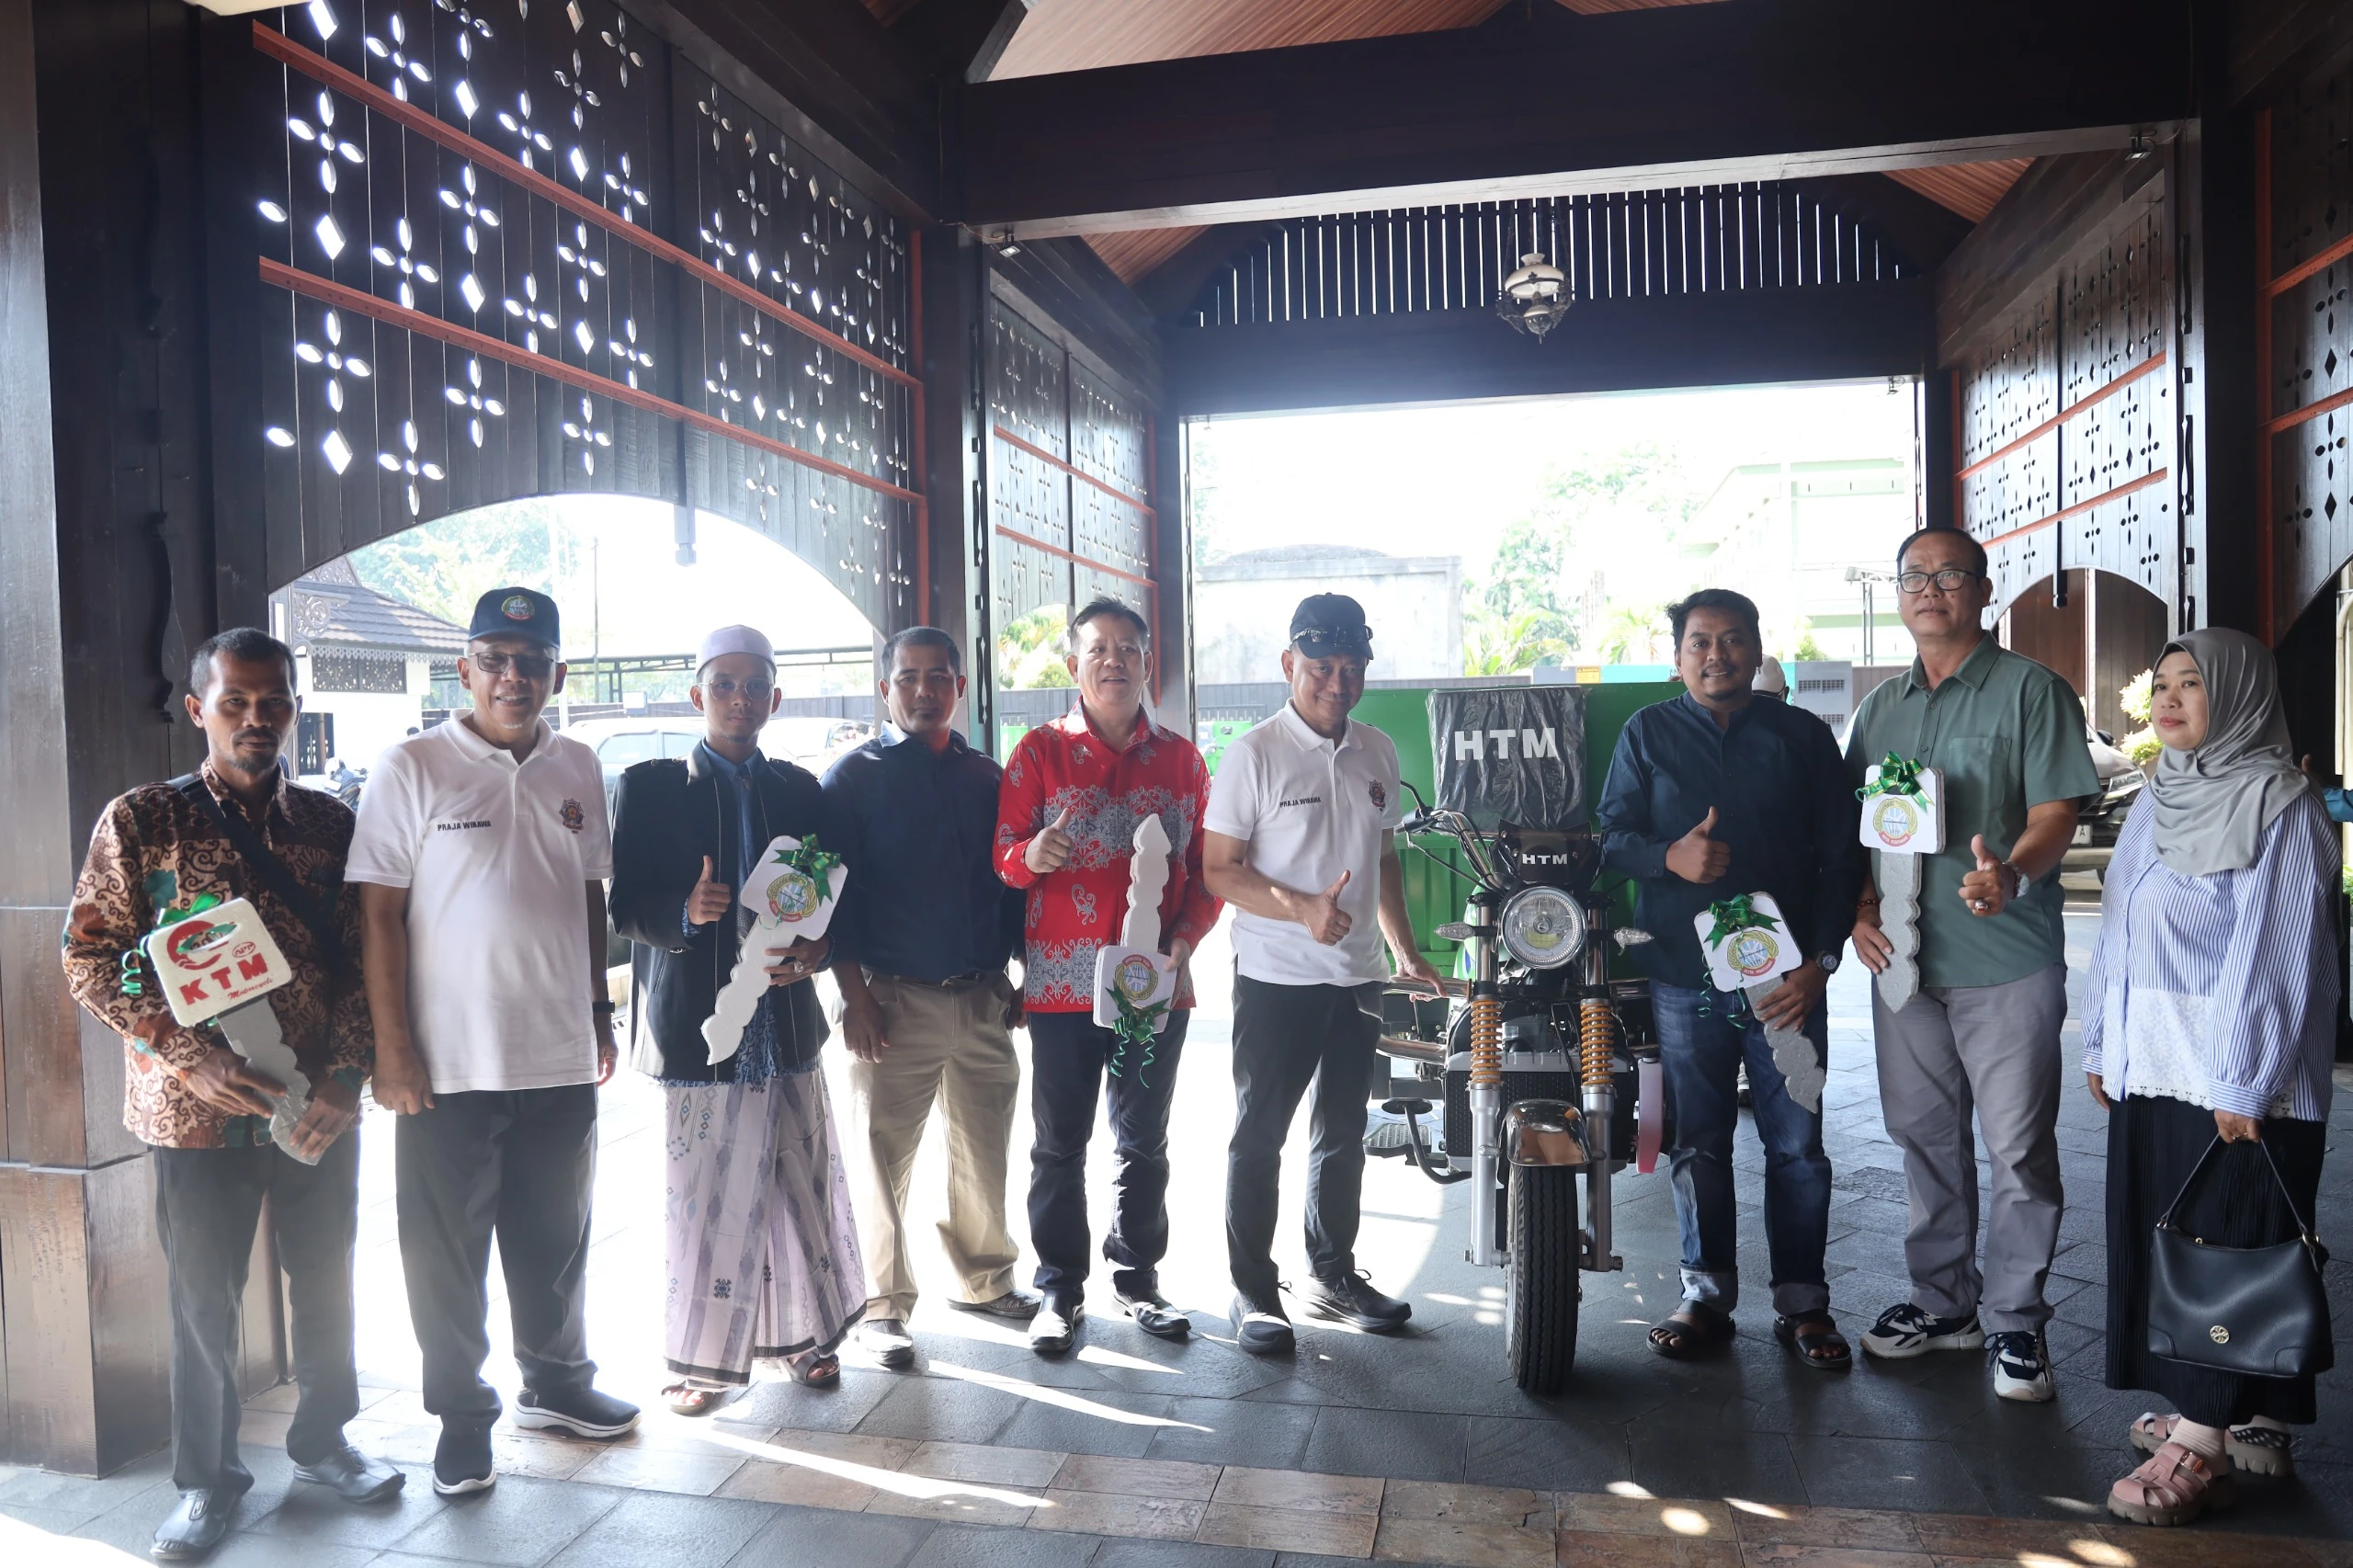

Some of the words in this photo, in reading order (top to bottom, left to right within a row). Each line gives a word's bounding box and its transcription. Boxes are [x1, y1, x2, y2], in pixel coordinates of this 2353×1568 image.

[1455, 727, 1557, 761] HTM
[1279, 800, 1300, 808] PRAJA
[438, 822, 461, 832] PRAJA
[1522, 853, 1568, 865] HTM
[179, 952, 268, 1006] KTM
